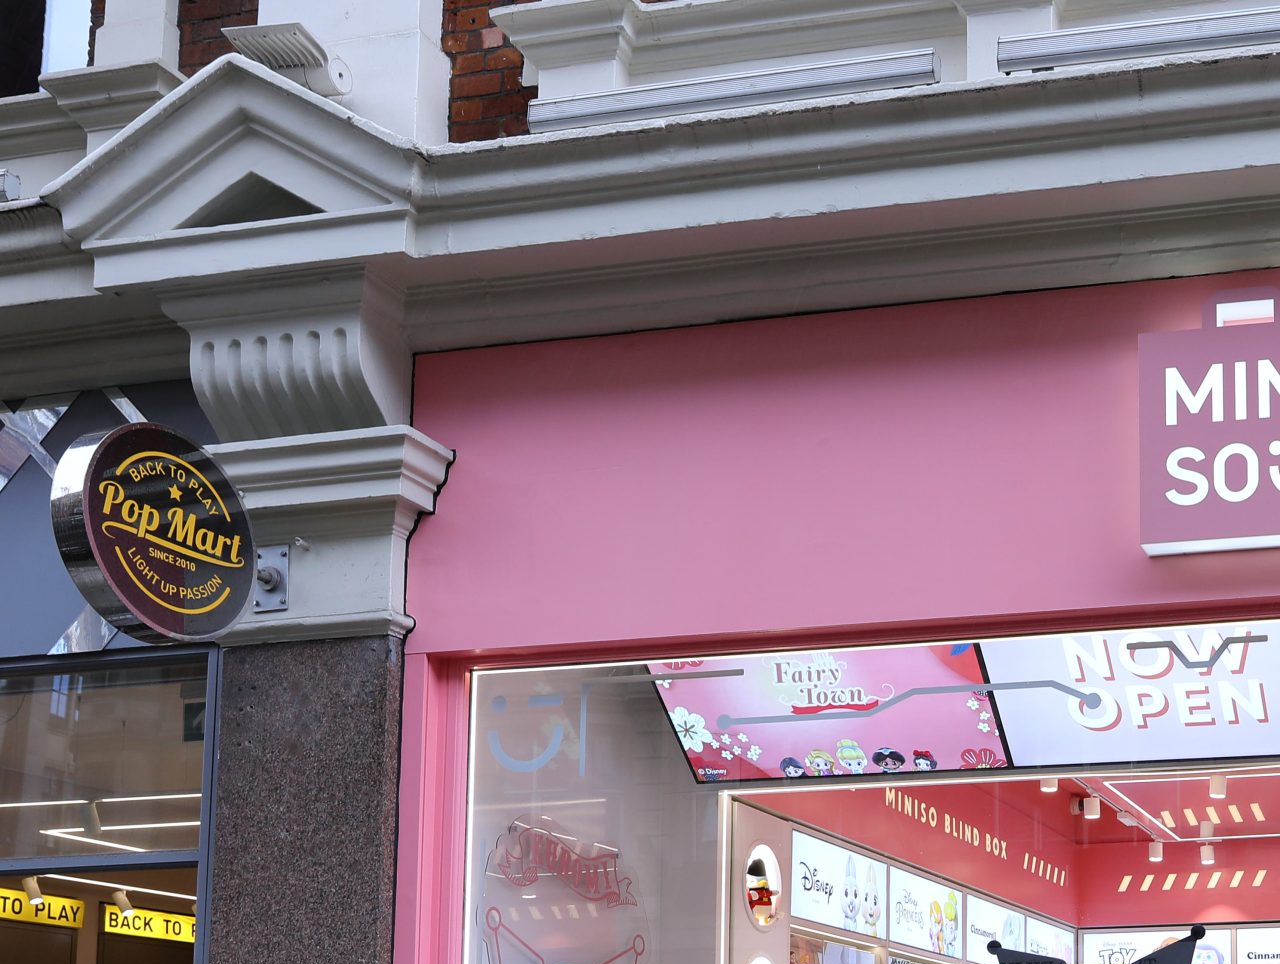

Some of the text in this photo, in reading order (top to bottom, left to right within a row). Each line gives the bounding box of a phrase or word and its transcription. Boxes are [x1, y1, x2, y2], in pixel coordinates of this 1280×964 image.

[129, 462, 219, 516] BACK TO PLAY
[99, 480, 244, 563] Pop Mart
[128, 547, 223, 600] LIGHT UP PASSION
[149, 548, 196, 571] SINCE 2010
[773, 662, 840, 685] Fairy
[1061, 626, 1252, 683] NOW
[799, 684, 863, 705] Town
[1067, 678, 1269, 732] OPEN
[885, 787, 1008, 860] MINISO BLIND BOX
[800, 861, 834, 904] Disney
[0, 896, 81, 923] TO PLAY
[108, 911, 153, 933] BACK
[163, 919, 182, 936] TO
